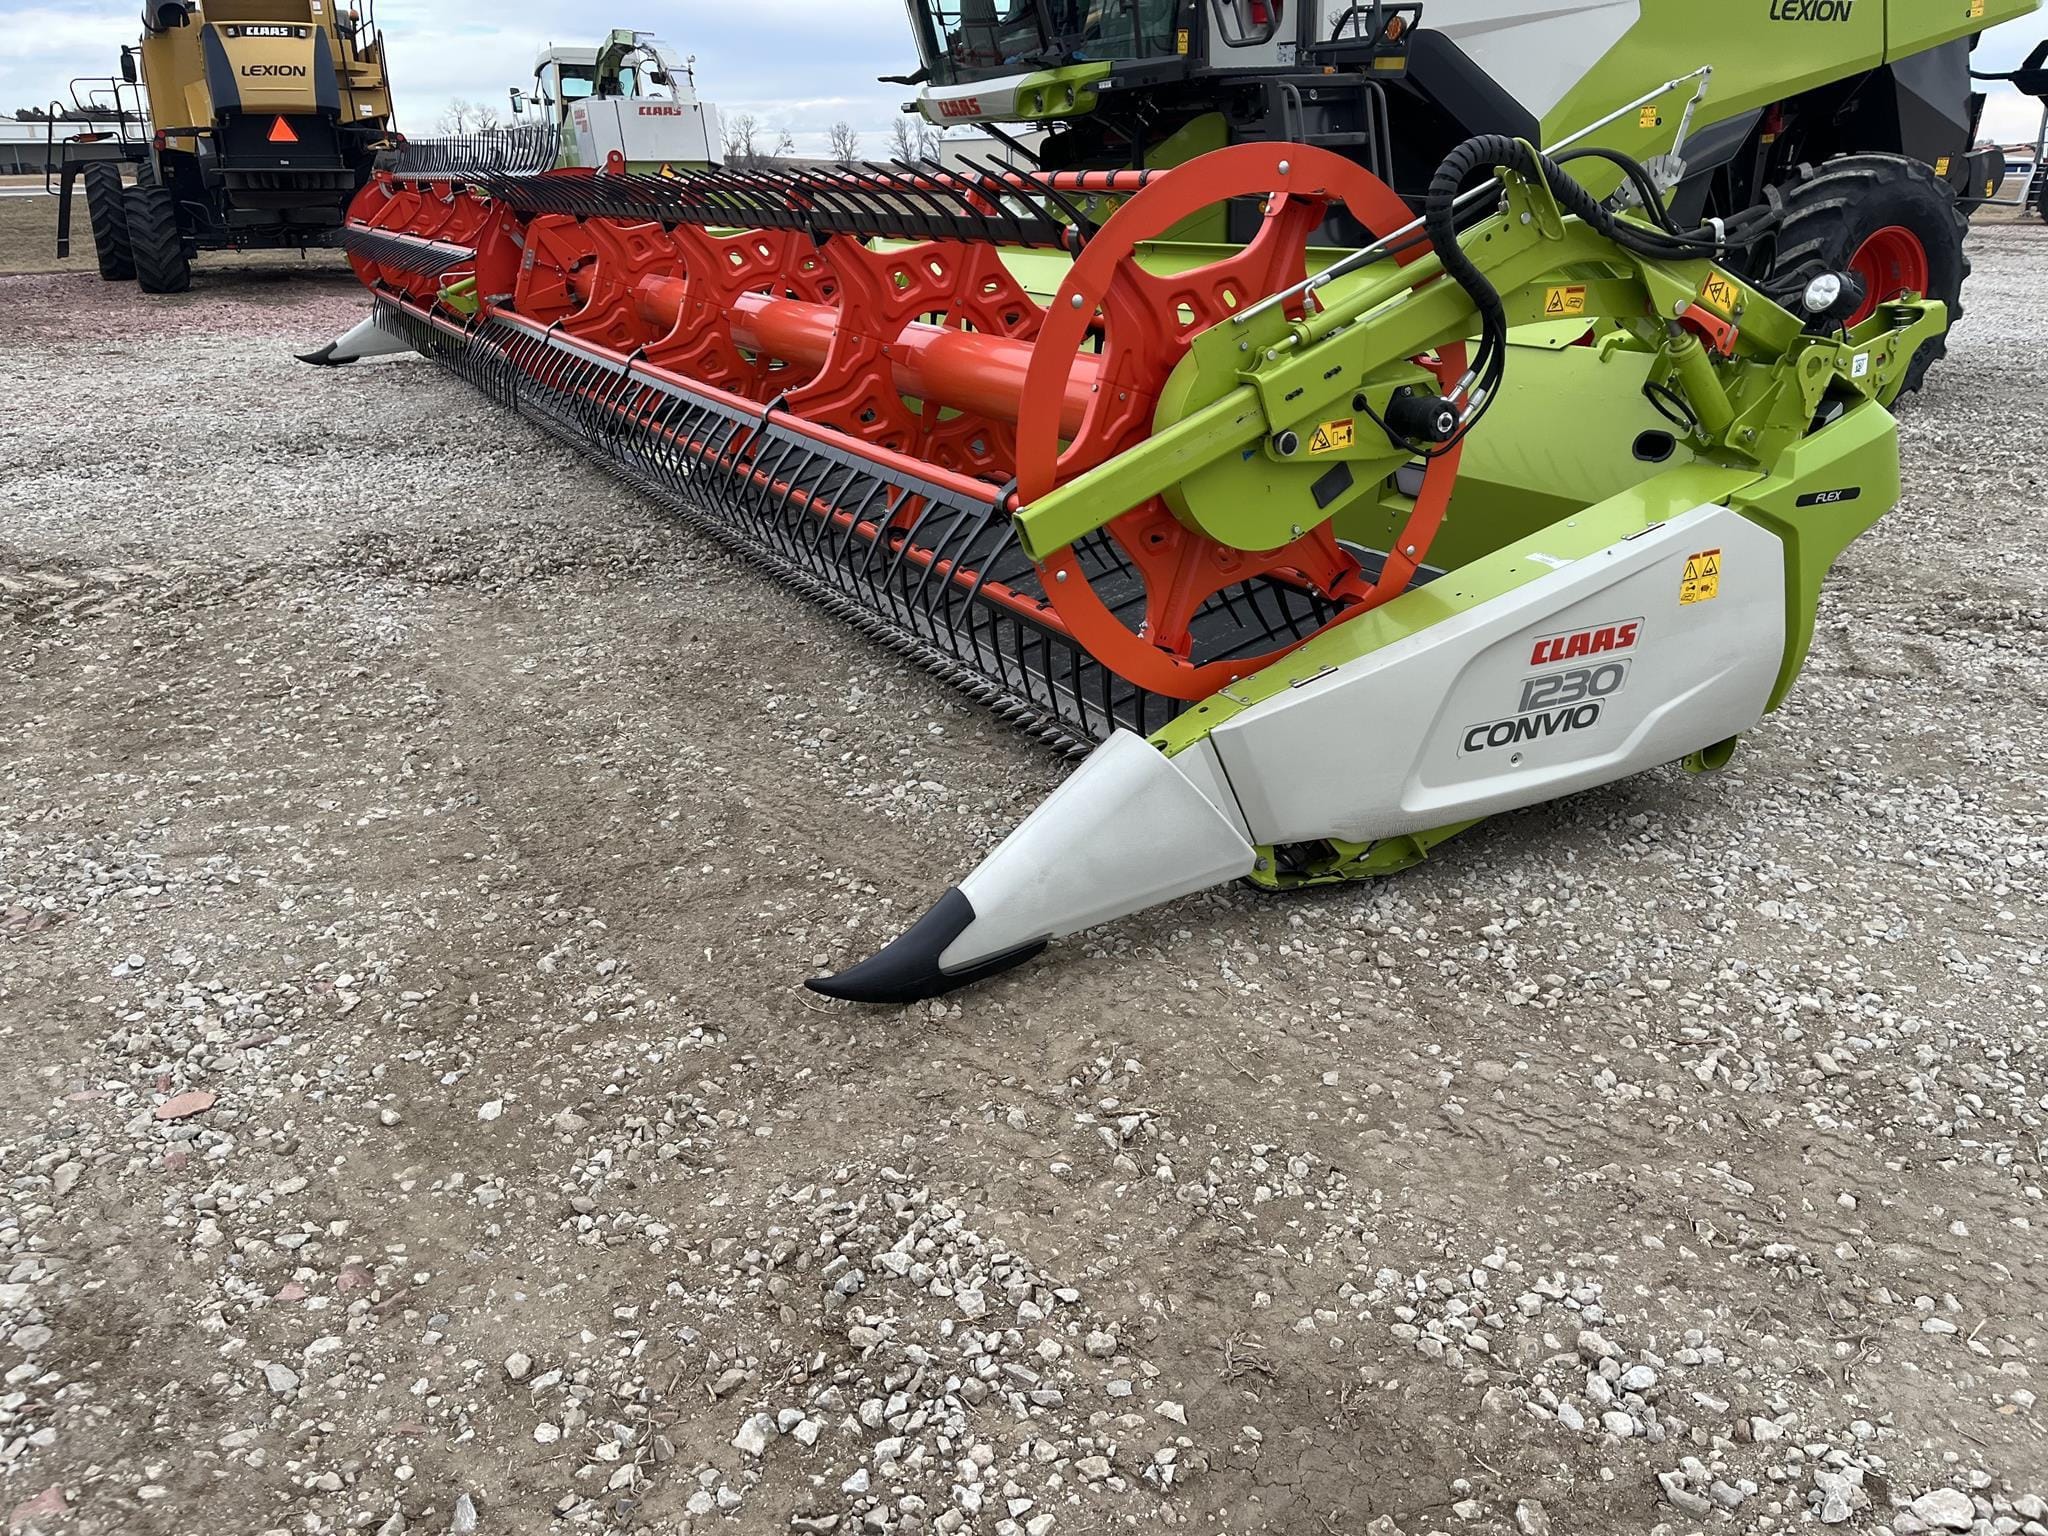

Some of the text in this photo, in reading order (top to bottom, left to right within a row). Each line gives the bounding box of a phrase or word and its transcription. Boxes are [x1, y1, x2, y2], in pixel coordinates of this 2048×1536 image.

[1769, 0, 1853, 21] LEXION
[246, 26, 289, 36] CLAAS
[241, 65, 307, 77] LEXION
[638, 106, 682, 116] CLAAS
[937, 97, 982, 117] CLAAS
[1815, 490, 1842, 504] FLEX
[1530, 622, 1638, 666] CLAAS
[1518, 663, 1624, 713] 1230
[1463, 703, 1600, 752] CONVIO
